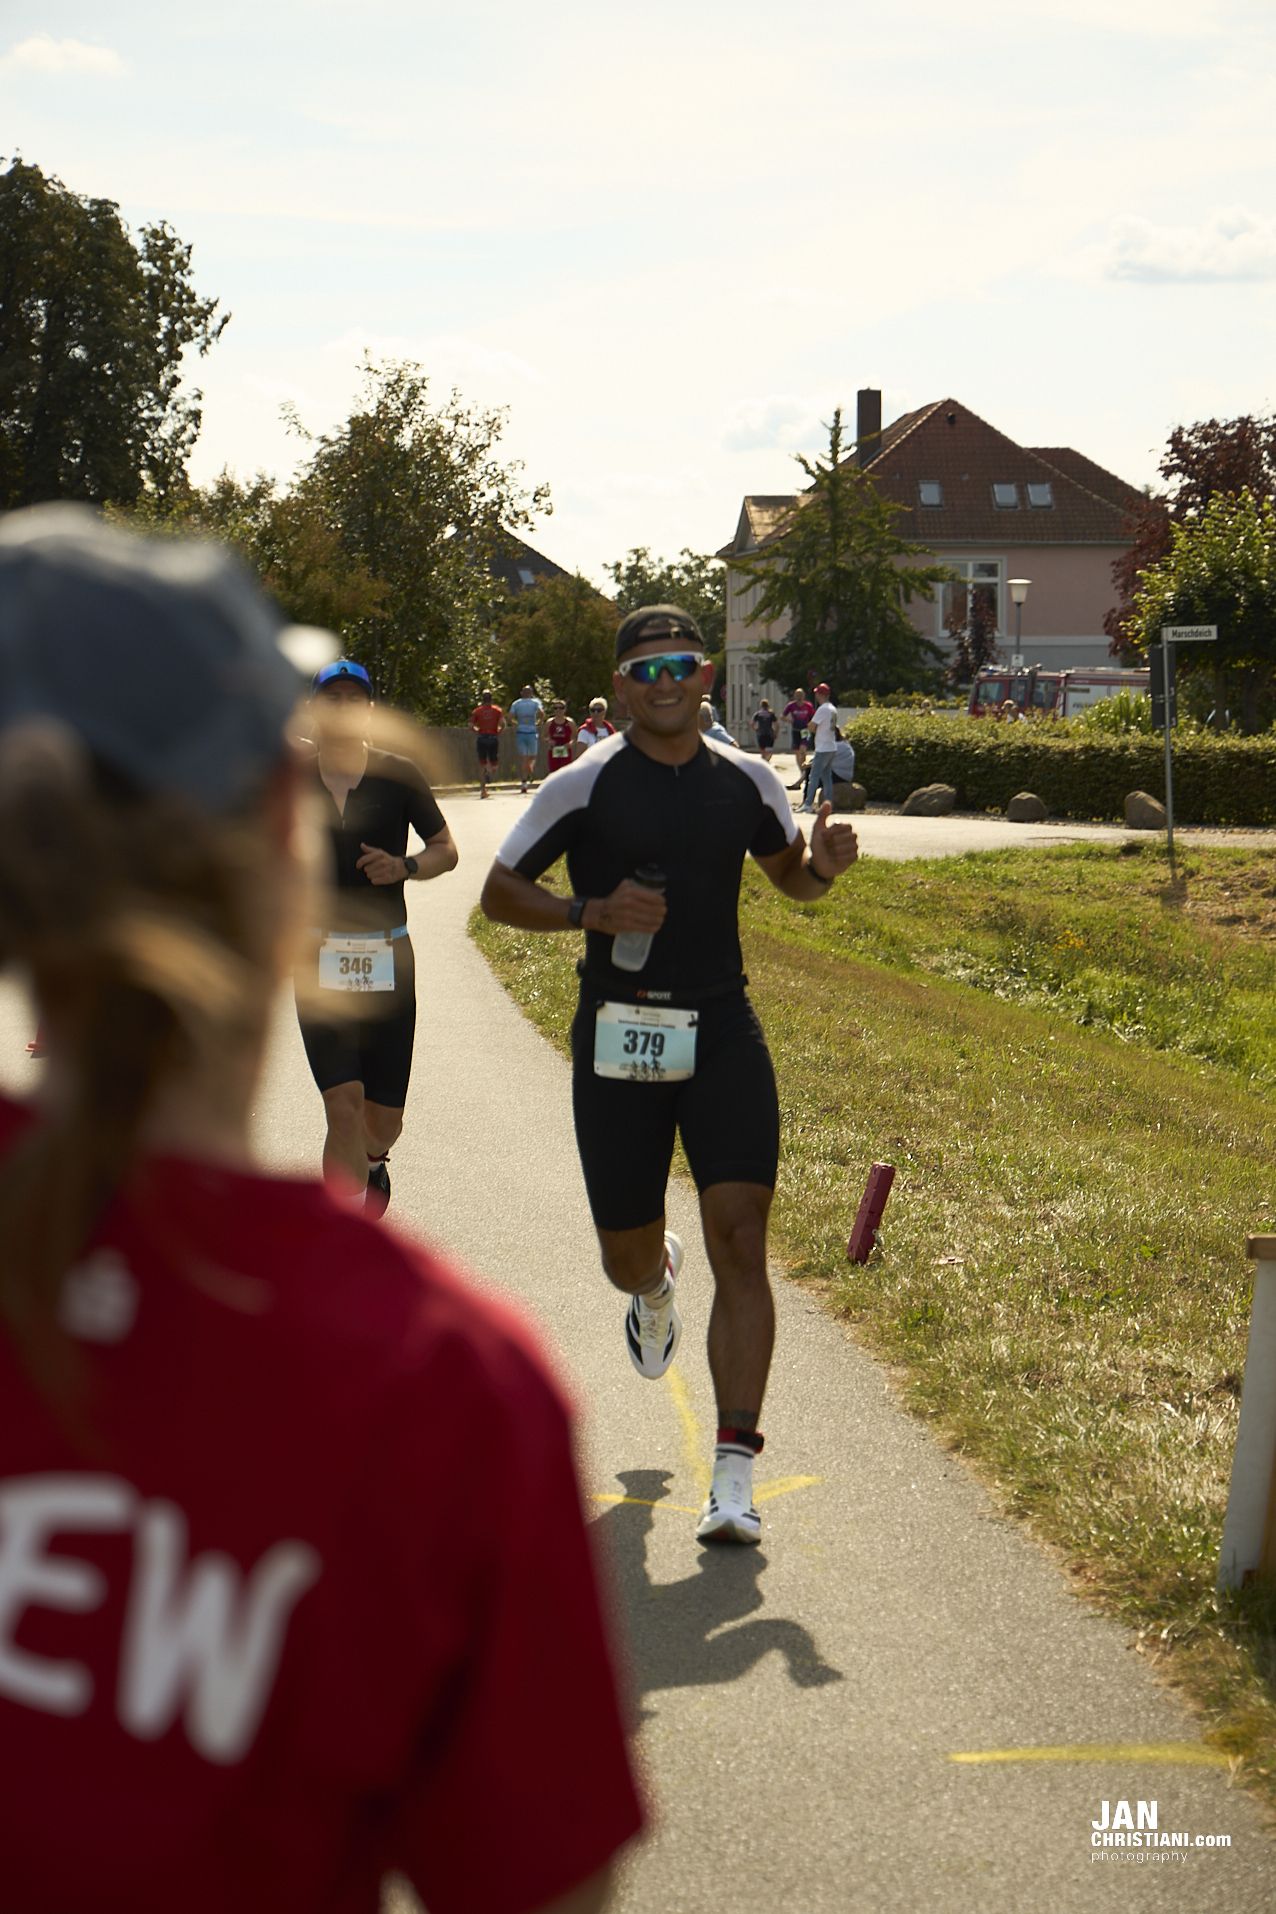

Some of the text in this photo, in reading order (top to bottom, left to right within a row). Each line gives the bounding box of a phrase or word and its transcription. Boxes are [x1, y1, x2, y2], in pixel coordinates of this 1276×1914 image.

[1171, 628, 1212, 638] Marschdeich
[339, 956, 373, 975] 346
[623, 1029, 665, 1057] 379
